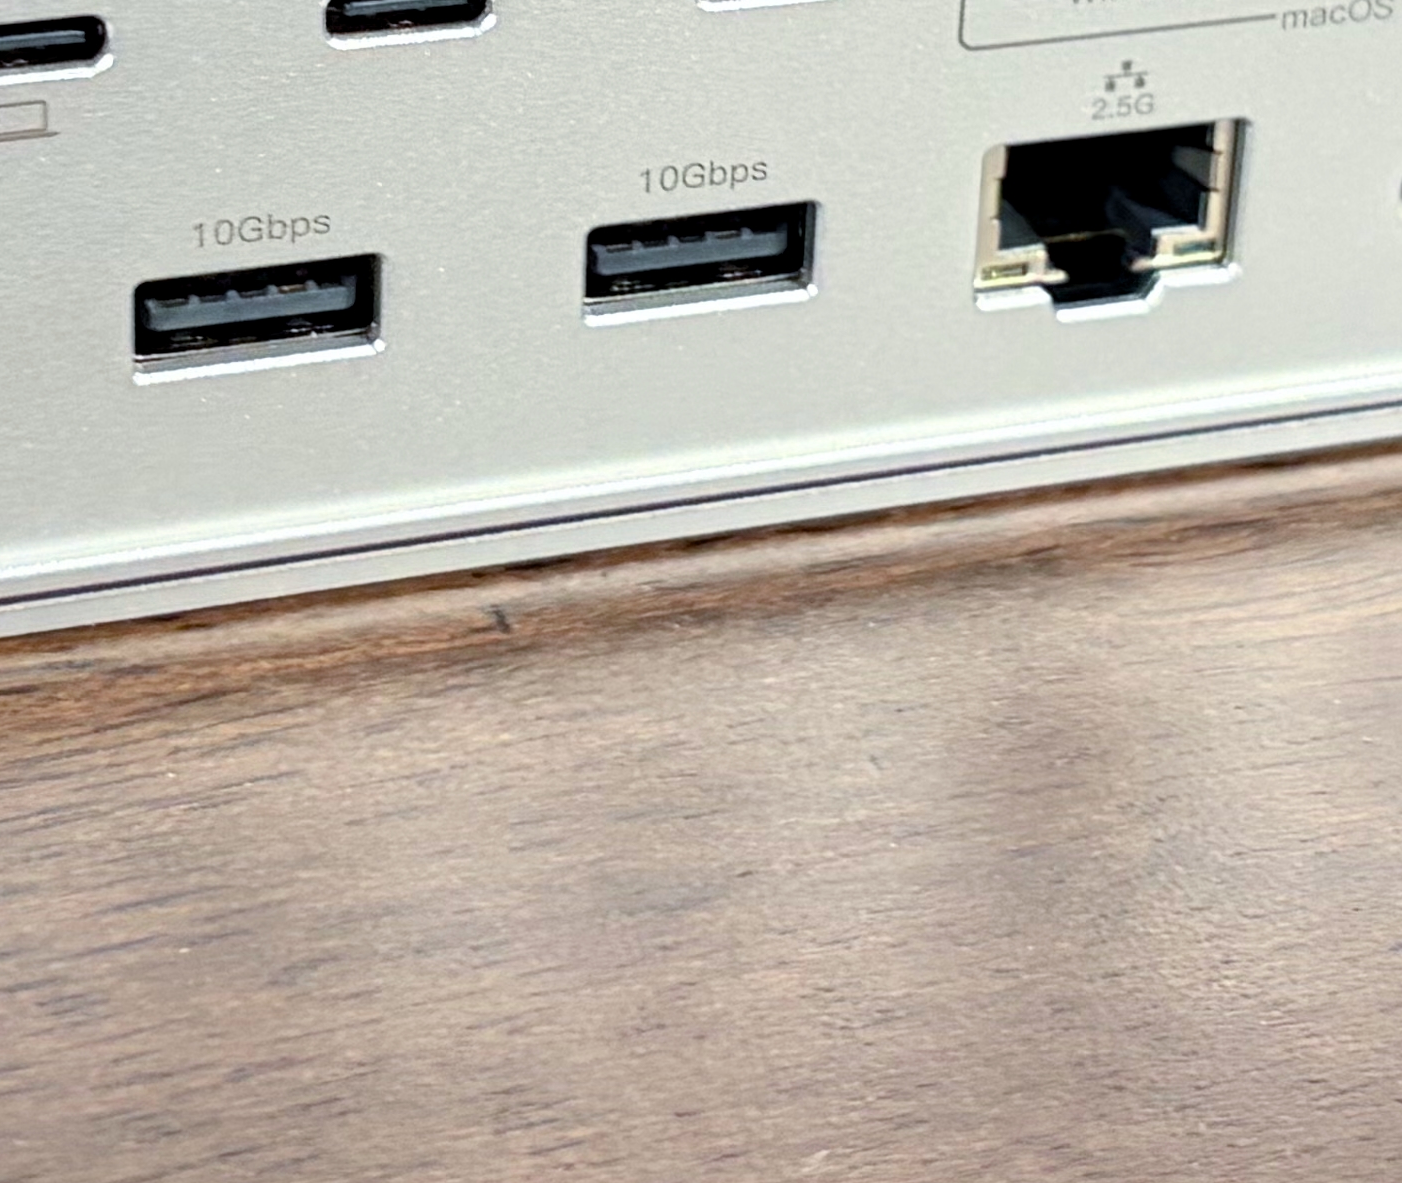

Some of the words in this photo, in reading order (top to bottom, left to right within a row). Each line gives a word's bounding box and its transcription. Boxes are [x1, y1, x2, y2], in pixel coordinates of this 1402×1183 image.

[1093, 94, 1155, 121] 2.5G
[640, 159, 768, 195] 10Gbps
[193, 214, 332, 249] 10Gbps
